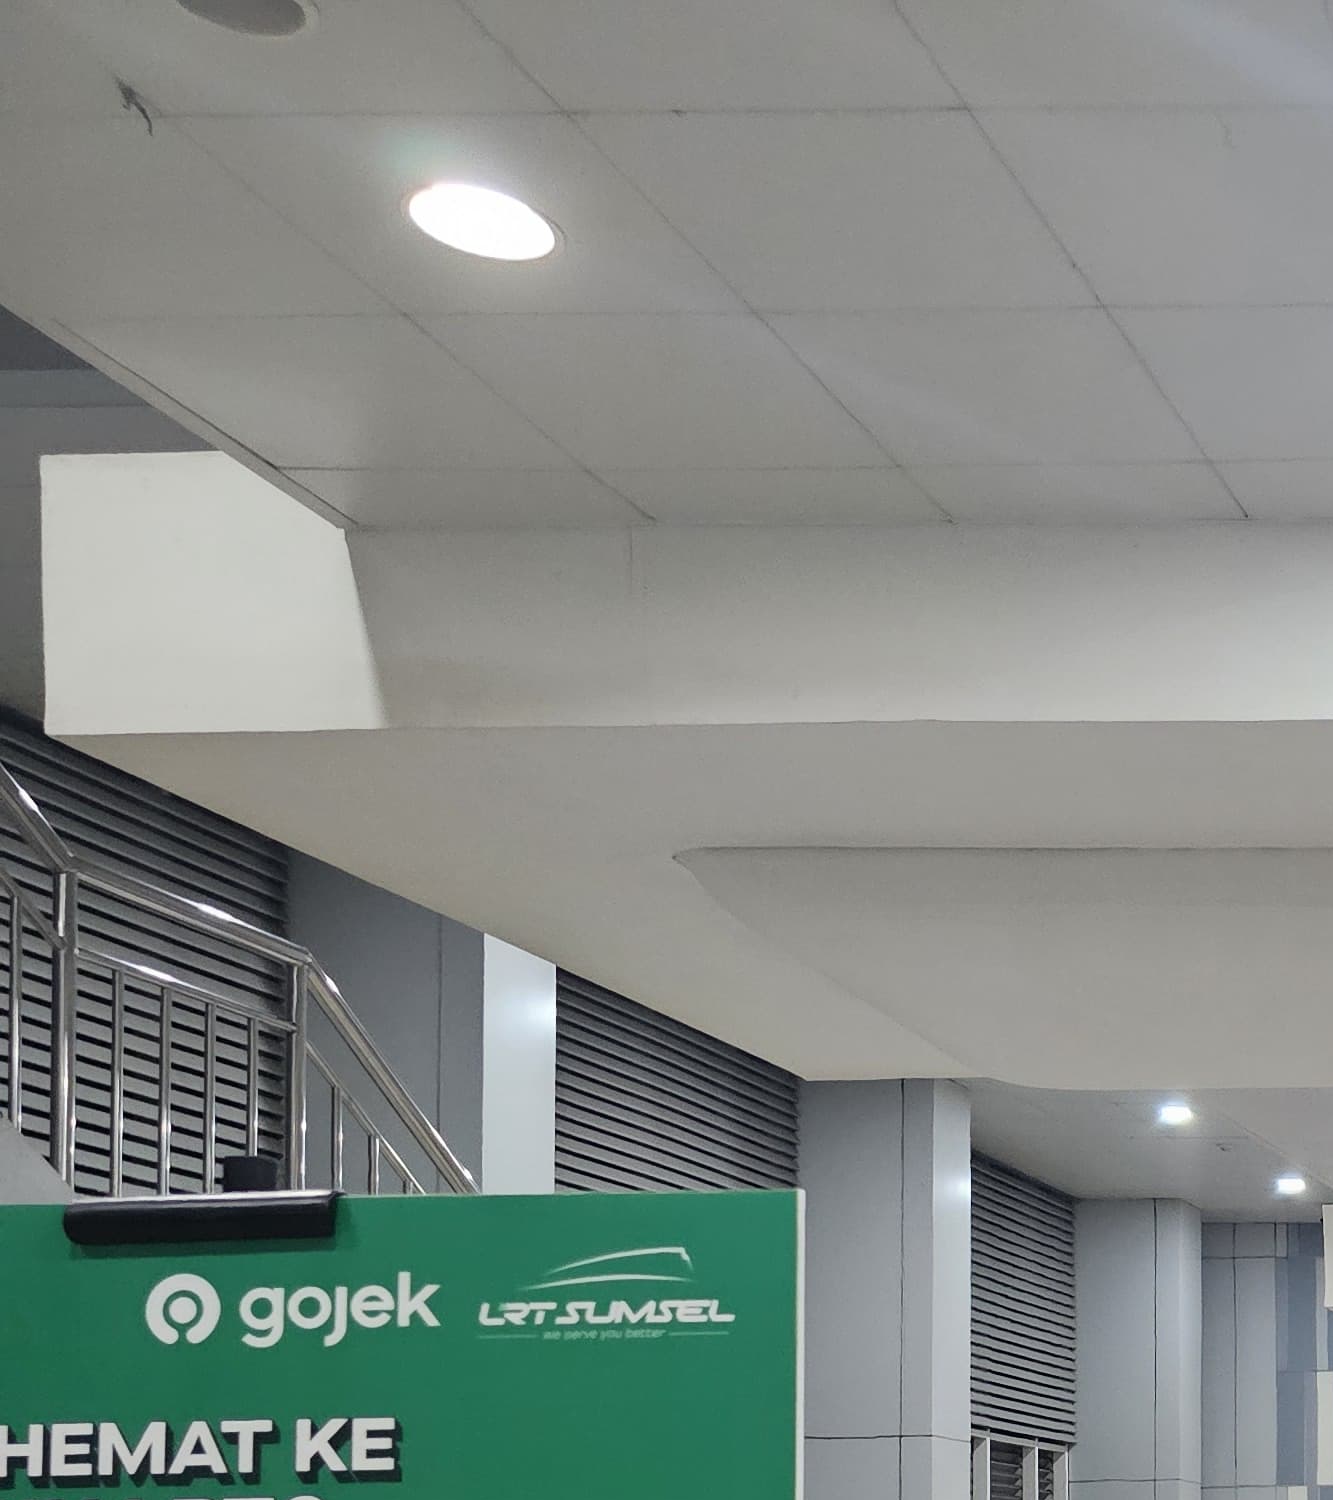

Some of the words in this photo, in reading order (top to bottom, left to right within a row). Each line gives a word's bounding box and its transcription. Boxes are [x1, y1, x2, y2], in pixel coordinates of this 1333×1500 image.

[239, 1271, 441, 1348] gojek
[478, 1302, 557, 1326] LRT
[555, 1299, 736, 1325] SUMSEL
[0, 1420, 273, 1478] HEMAT
[295, 1417, 396, 1473] KE
